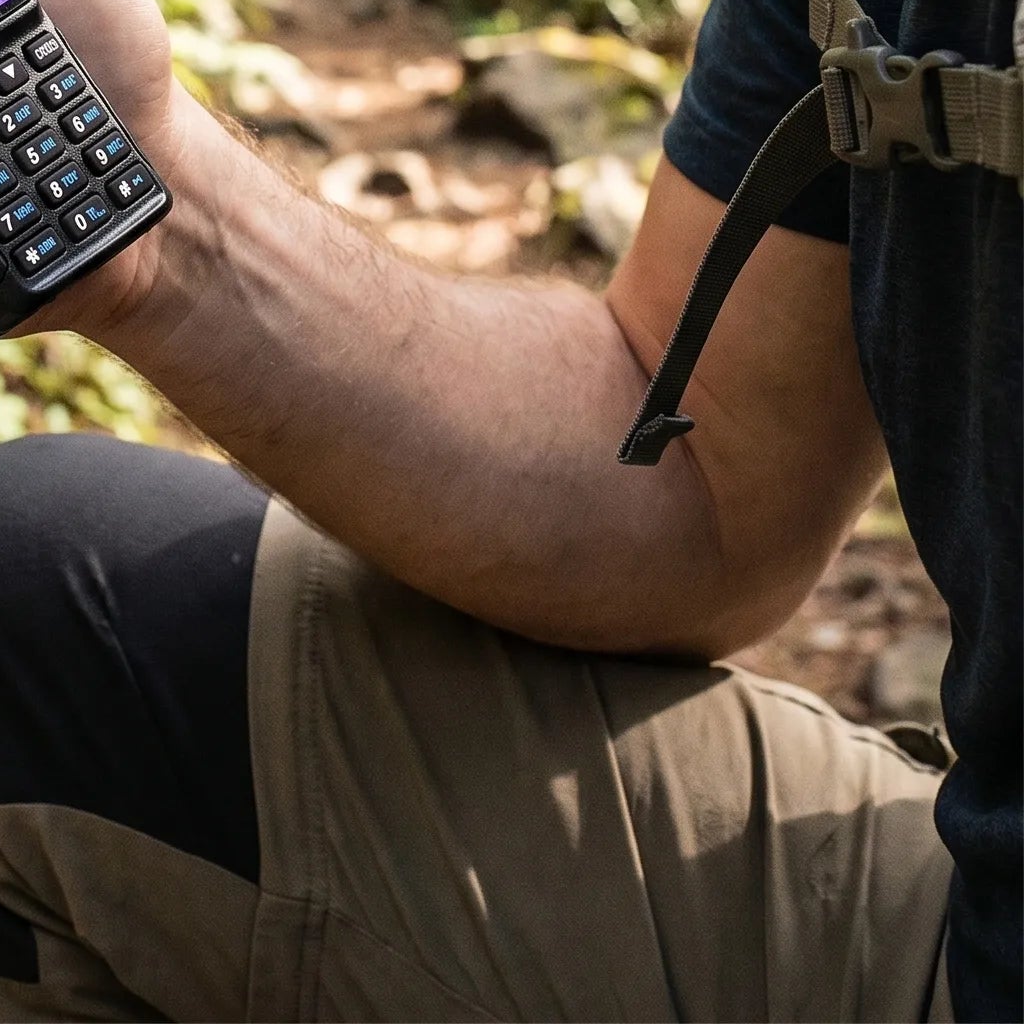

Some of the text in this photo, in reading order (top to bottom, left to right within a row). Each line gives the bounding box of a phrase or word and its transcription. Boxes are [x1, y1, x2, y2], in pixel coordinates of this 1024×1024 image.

[49, 83, 63, 99] 3
[2, 114, 16, 132] 2
[72, 116, 85, 132] 6
[26, 147, 40, 164] 5
[95, 148, 108, 165] 9
[49, 181, 63, 198] 8
[0, 213, 13, 231] 7
[74, 213, 87, 231] 0
